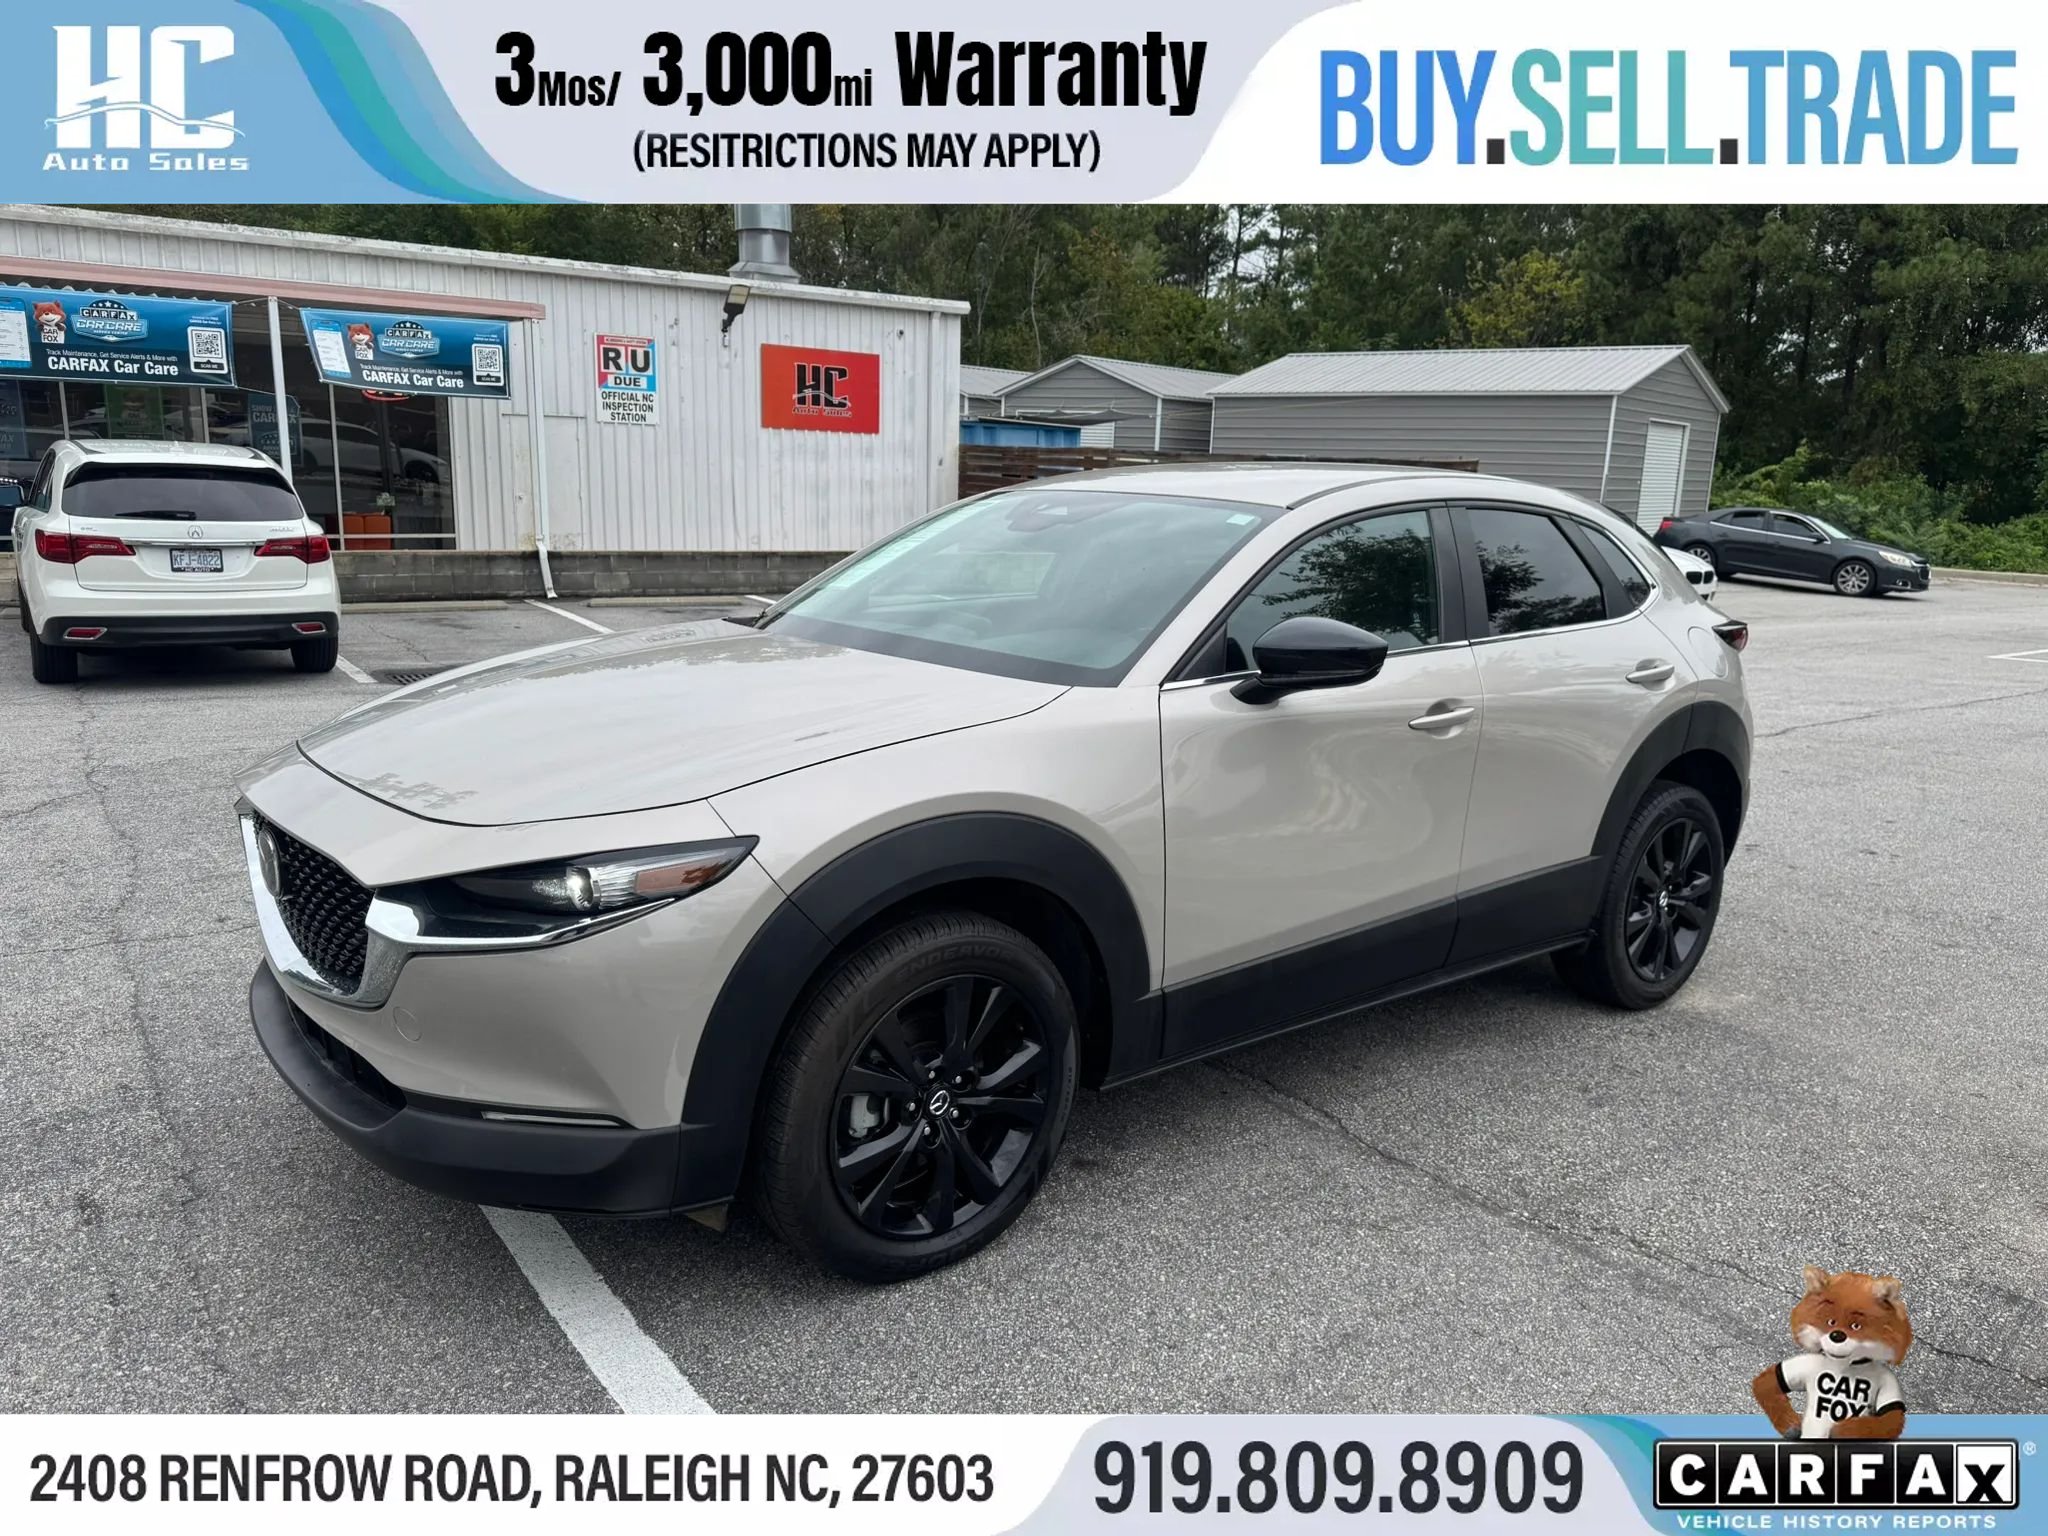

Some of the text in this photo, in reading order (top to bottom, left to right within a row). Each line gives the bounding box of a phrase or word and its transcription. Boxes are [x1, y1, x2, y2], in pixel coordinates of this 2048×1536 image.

[82, 309, 135, 320] CARFAX
[387, 329, 431, 339] CARFAX
[602, 347, 651, 373] R U
[48, 356, 179, 376] CARFAX Car Care
[362, 370, 464, 388] CARFAX Car Care
[614, 376, 641, 387] DUE
[795, 363, 849, 409] HC
[601, 391, 654, 402] OFFICIAL NC
[602, 401, 654, 413] INSPECTION
[610, 412, 647, 422] STATION
